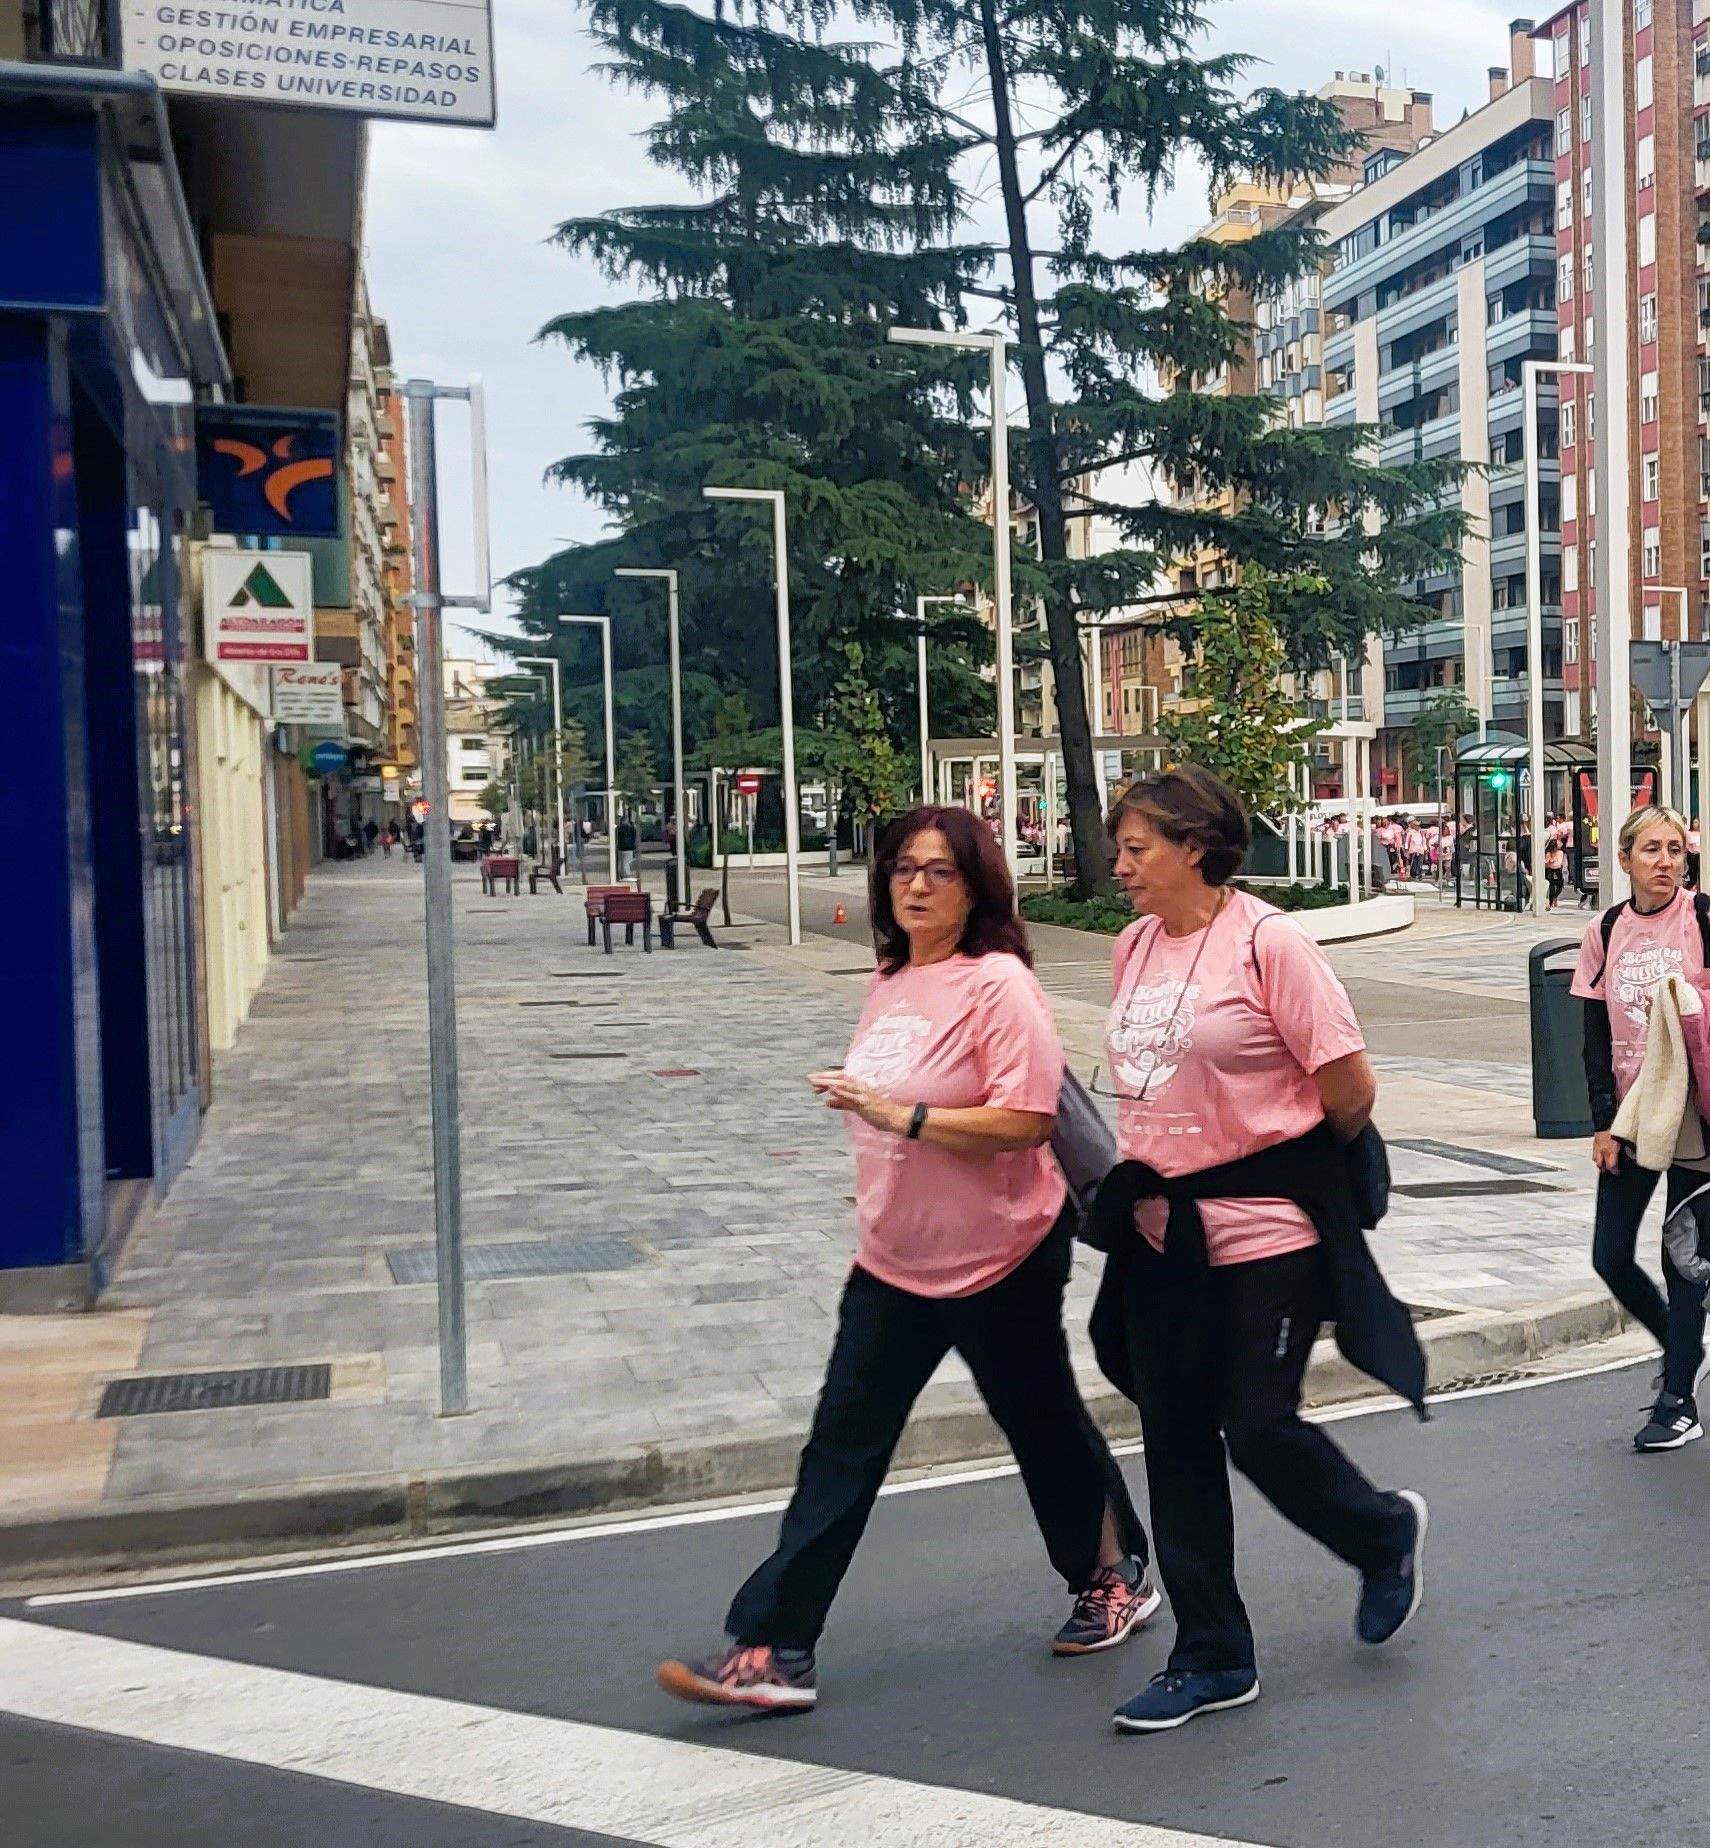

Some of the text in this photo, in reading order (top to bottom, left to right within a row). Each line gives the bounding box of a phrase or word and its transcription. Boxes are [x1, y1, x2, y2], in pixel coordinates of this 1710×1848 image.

[157, 6, 477, 56] GESTIÓN EMPRESARIAL
[157, 34, 480, 83] OPOSICIONES-REPASOS
[159, 62, 457, 108] CLASES UNIVERSIDAD
